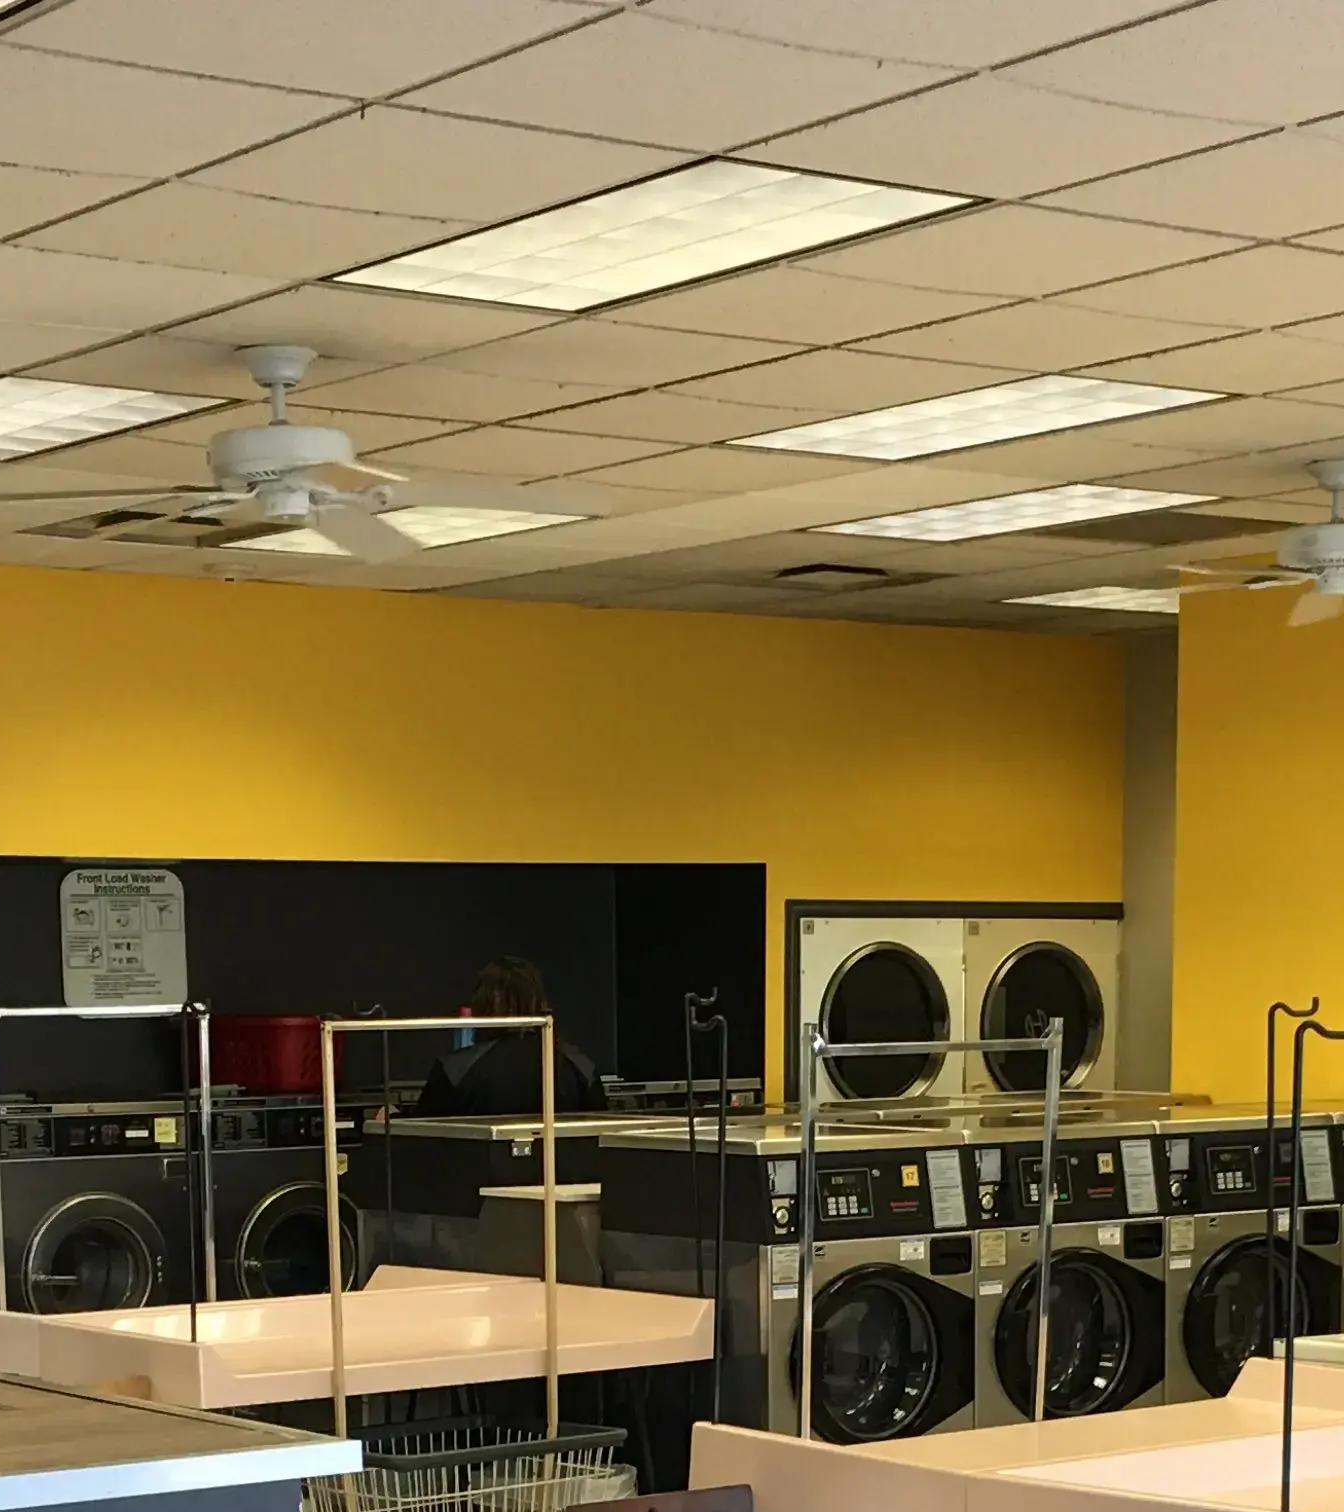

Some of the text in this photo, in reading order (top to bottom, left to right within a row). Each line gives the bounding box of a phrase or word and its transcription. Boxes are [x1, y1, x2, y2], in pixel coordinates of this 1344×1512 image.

[76, 873, 167, 883] Front Load Washer
[93, 884, 151, 894] Instructions
[906, 1171, 915, 1181] 17
